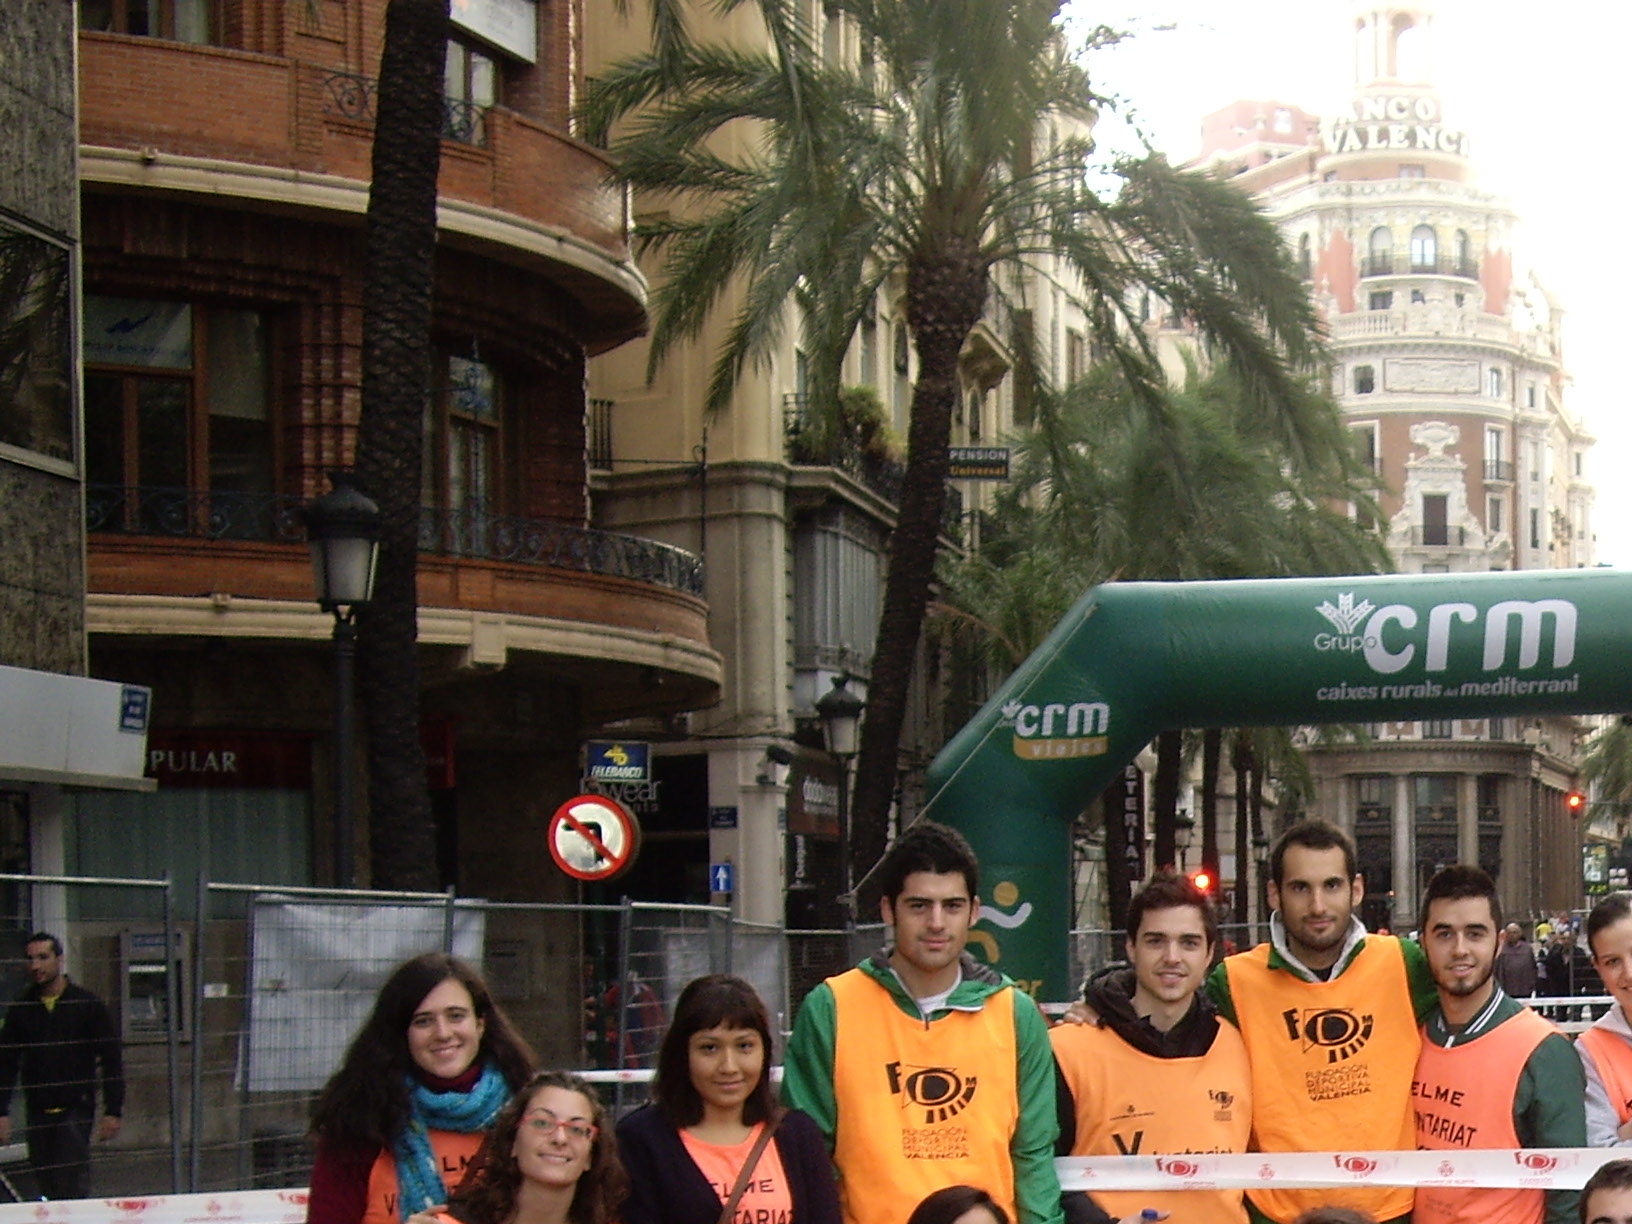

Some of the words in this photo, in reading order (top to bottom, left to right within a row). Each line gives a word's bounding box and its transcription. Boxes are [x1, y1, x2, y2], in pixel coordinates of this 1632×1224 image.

[1338, 96, 1438, 124] ANCO
[1322, 126, 1471, 157] VALENCI
[949, 450, 1007, 460] PENSION
[1314, 633, 1377, 653] Grupo
[1363, 599, 1578, 674] crm
[1316, 682, 1377, 701] caixes
[1381, 680, 1443, 699] rurals
[1460, 674, 1580, 698] mediterrani
[1015, 702, 1110, 737] crm
[1124, 765, 1140, 858] ETERIA
[1310, 1087, 1372, 1101] VALENCIA
[1411, 1081, 1465, 1107] ELME
[1414, 1111, 1478, 1148] NTARIAT
